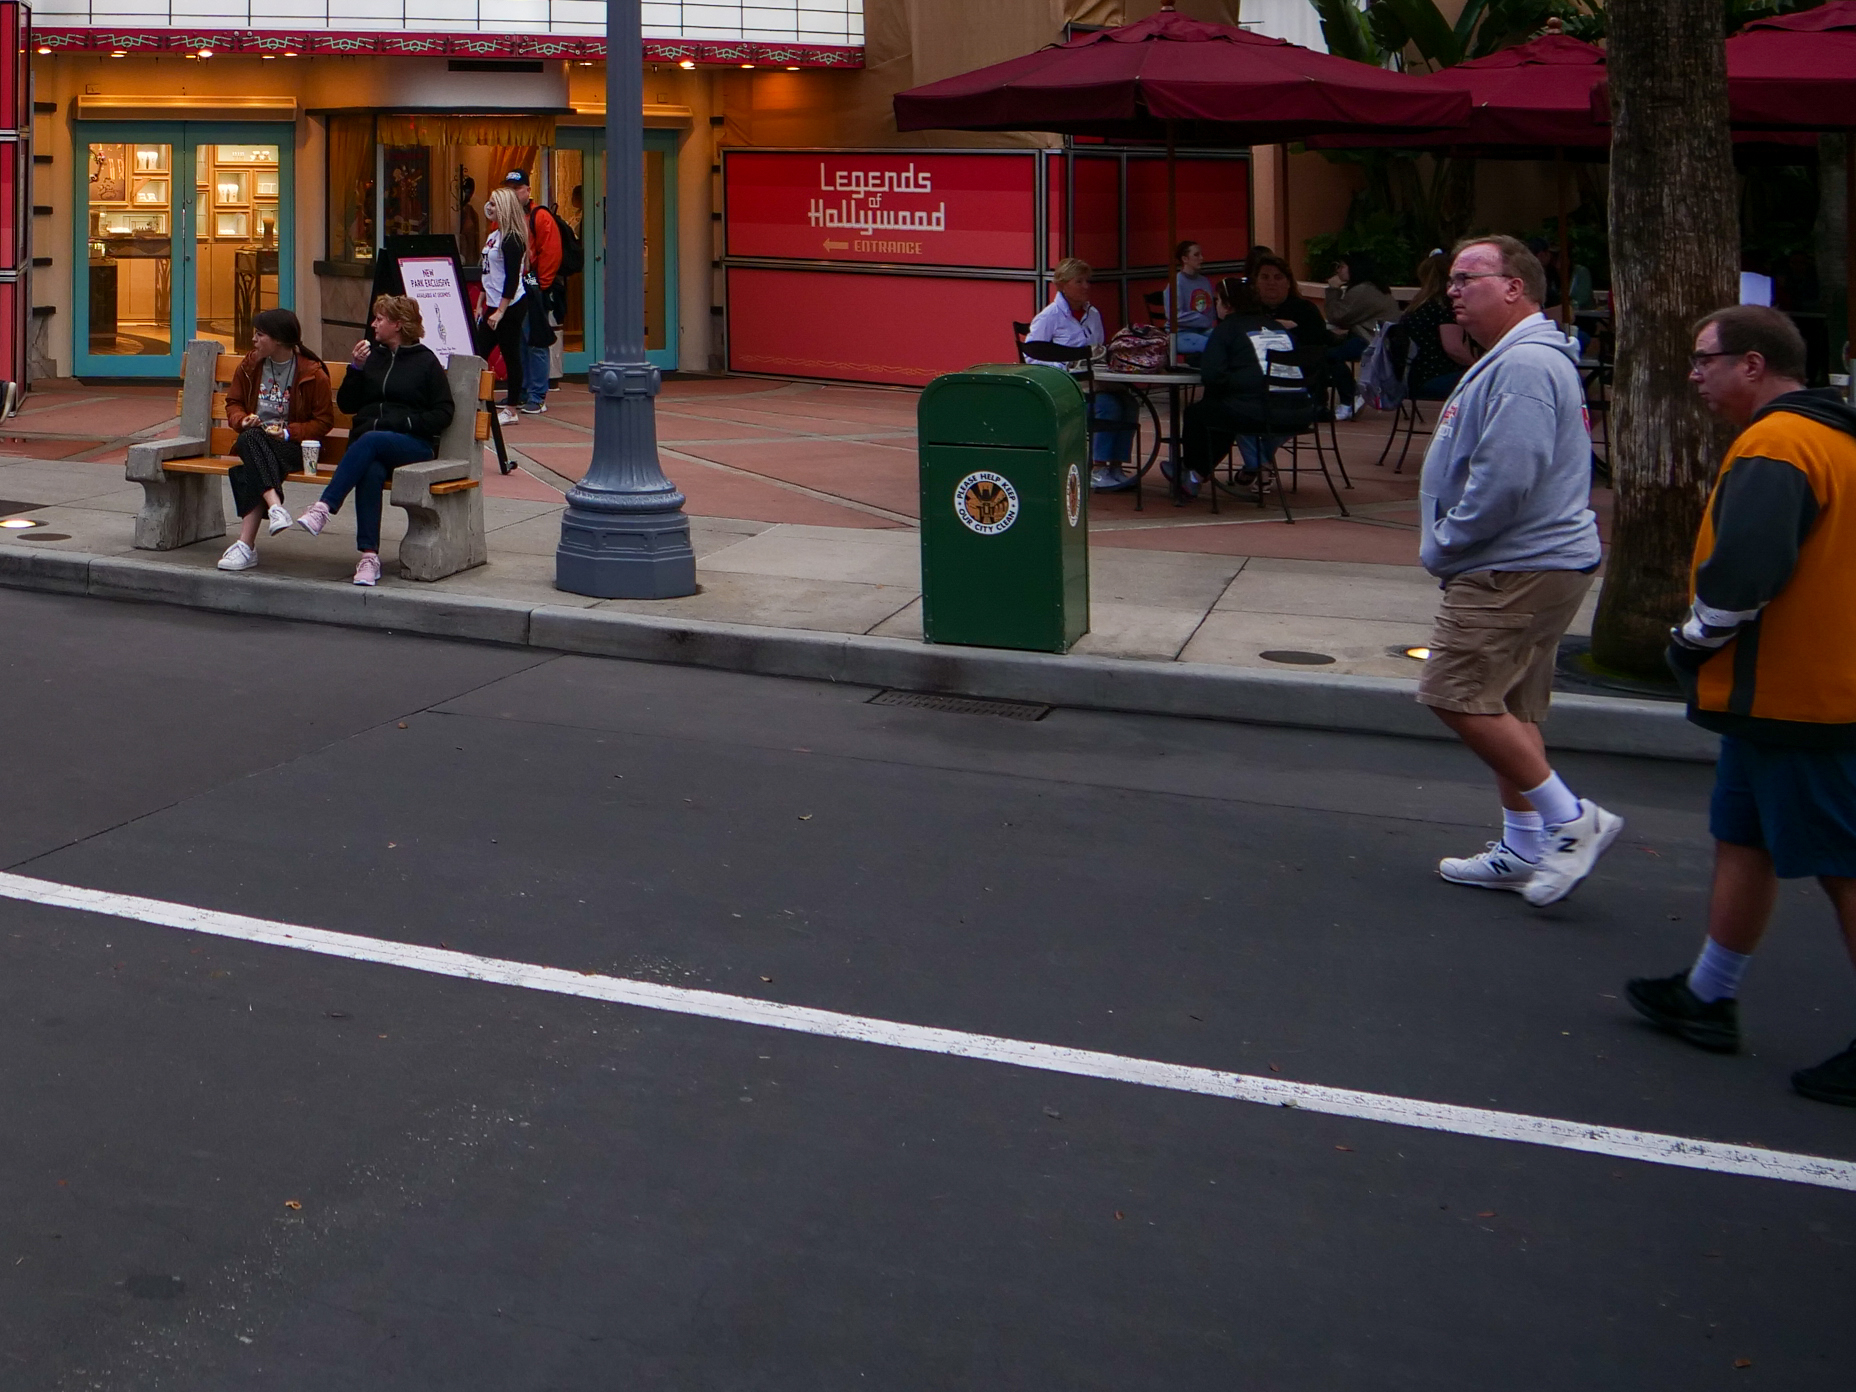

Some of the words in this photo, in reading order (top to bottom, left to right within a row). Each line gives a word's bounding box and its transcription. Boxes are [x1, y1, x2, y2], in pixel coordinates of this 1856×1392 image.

[821, 163, 931, 198] Legends
[869, 193, 882, 208] of
[808, 199, 945, 235] Hollywood
[854, 240, 923, 255] ENTRANCE
[410, 279, 424, 288] PARK
[424, 278, 451, 287] EXCLUSIVE
[422, 269, 434, 277] NEW
[956, 475, 978, 500] PLEASE
[980, 473, 1001, 483] HELP
[1001, 482, 1016, 501] KEEP
[959, 508, 973, 526] OUR
[974, 524, 993, 533] CITY
[995, 510, 1016, 531] CLEAN
